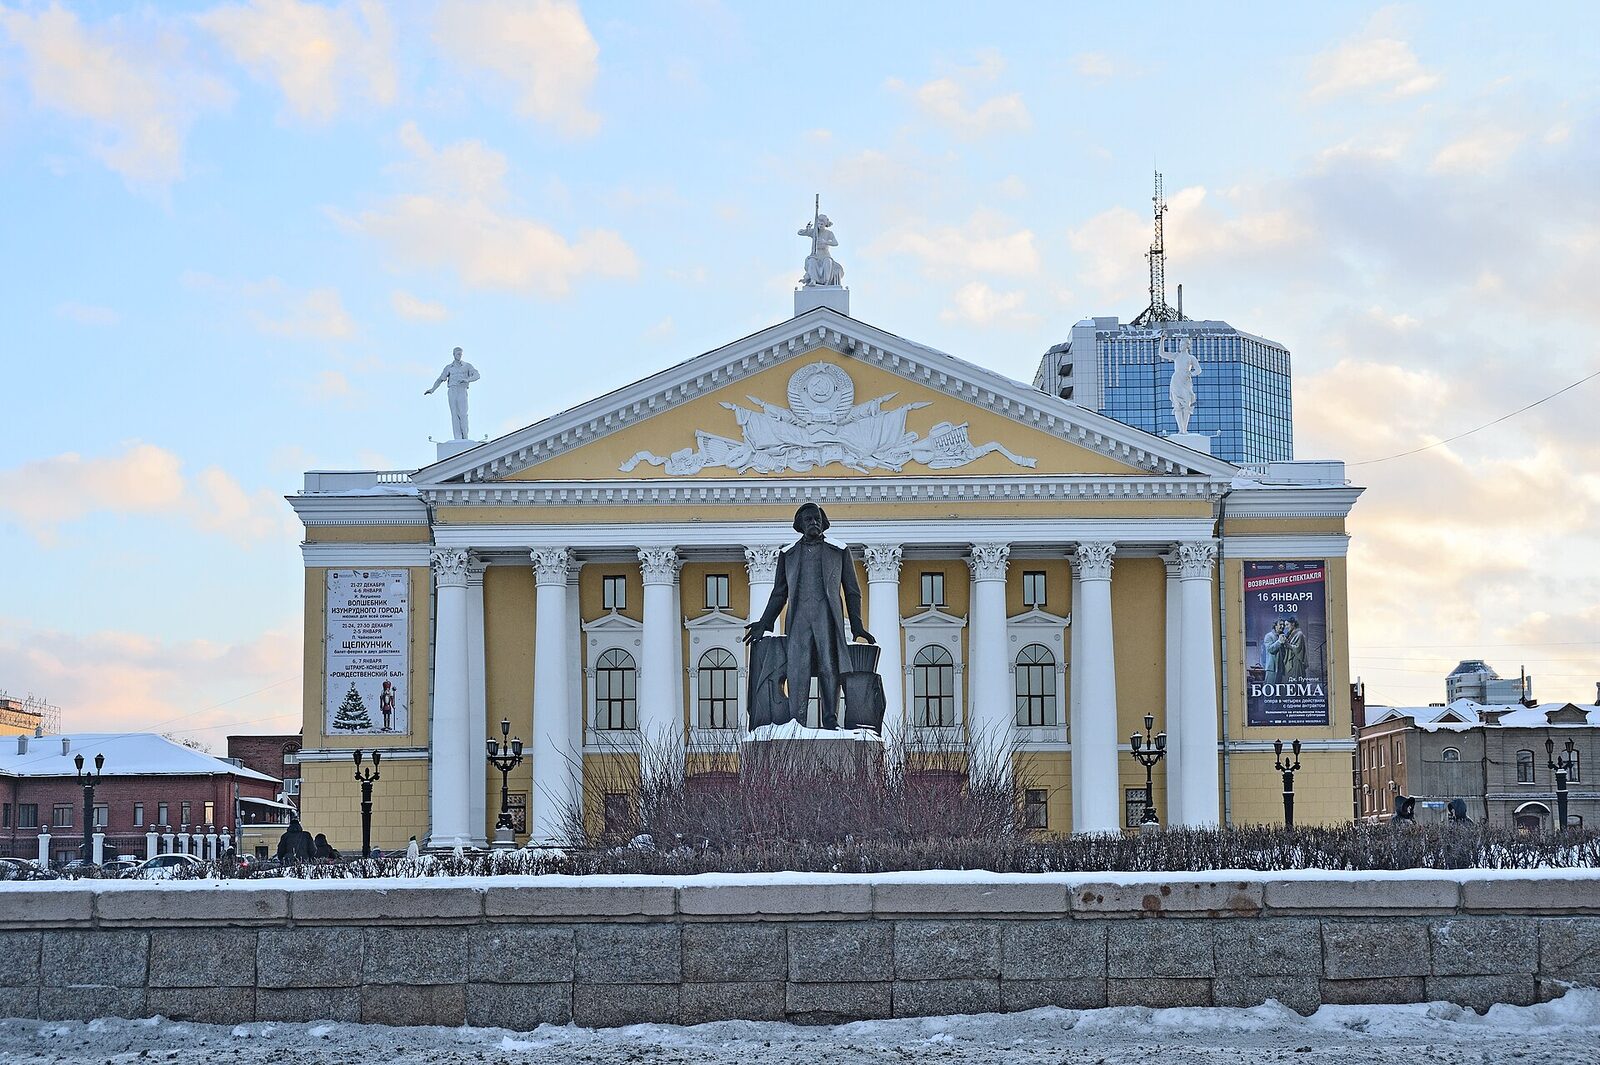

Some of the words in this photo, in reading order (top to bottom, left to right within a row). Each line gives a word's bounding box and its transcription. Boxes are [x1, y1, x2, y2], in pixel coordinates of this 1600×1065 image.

[1248, 576, 1289, 588] ВОЗВРАЩЕНИЕ
[1289, 572, 1322, 582] СПЕКТАКЛЯ
[1257, 593, 1268, 601] 16
[1271, 592, 1313, 601] ЯНВАРЯ
[1273, 604, 1298, 612] 18.30
[342, 641, 392, 649] ЩЕЛКУНЧИК
[1251, 684, 1324, 696] БОГЕМА
